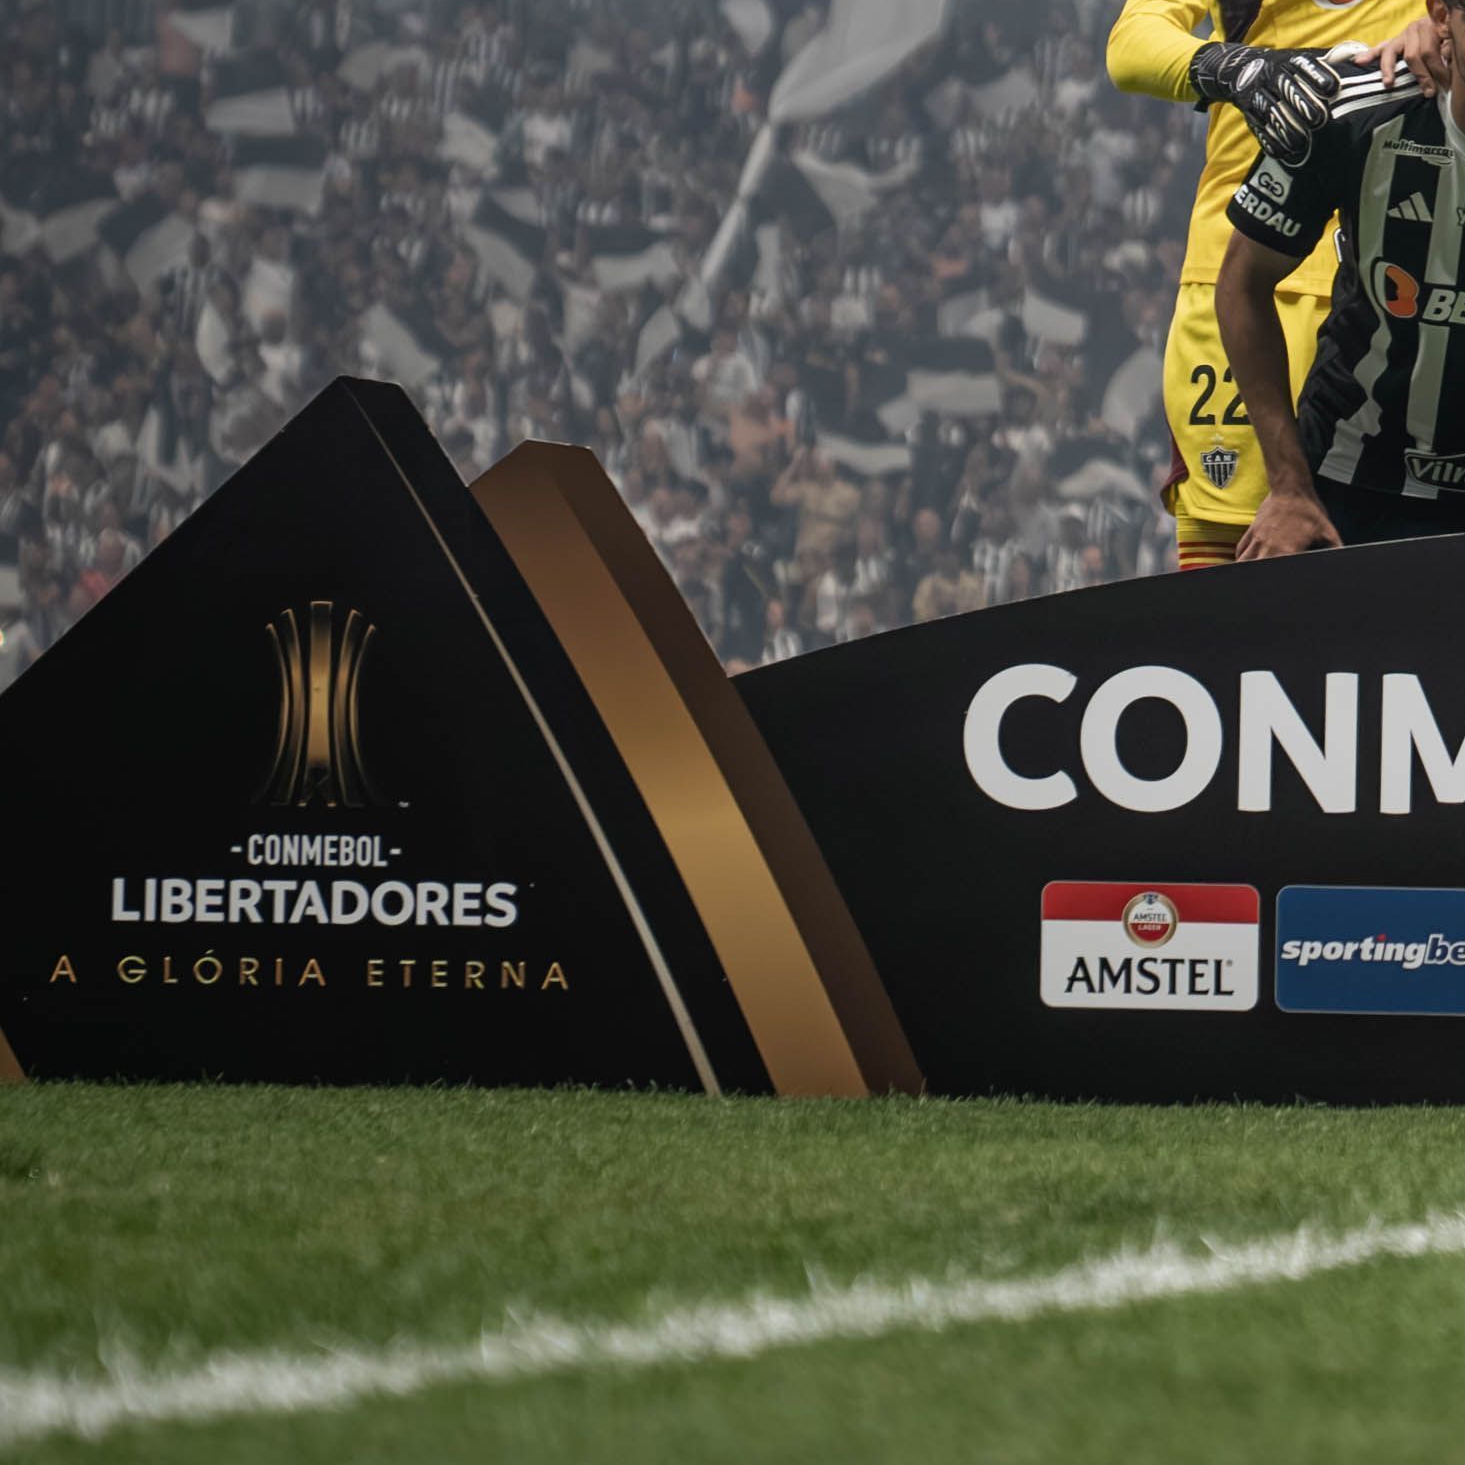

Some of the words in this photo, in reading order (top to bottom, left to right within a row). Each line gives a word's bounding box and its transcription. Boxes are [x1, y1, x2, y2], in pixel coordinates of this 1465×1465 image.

[1234, 184, 1301, 237] ERDAU
[1188, 364, 1253, 426] 22
[1205, 454, 1233, 464] CAM
[111, 877, 518, 927] LIBERTADORES
[1133, 913, 1167, 922] AMSTEL
[50, 954, 77, 983] A
[117, 949, 327, 987] GLÓRIA
[367, 958, 569, 990] ETERNA
[1065, 957, 1234, 996] AMSTEL
